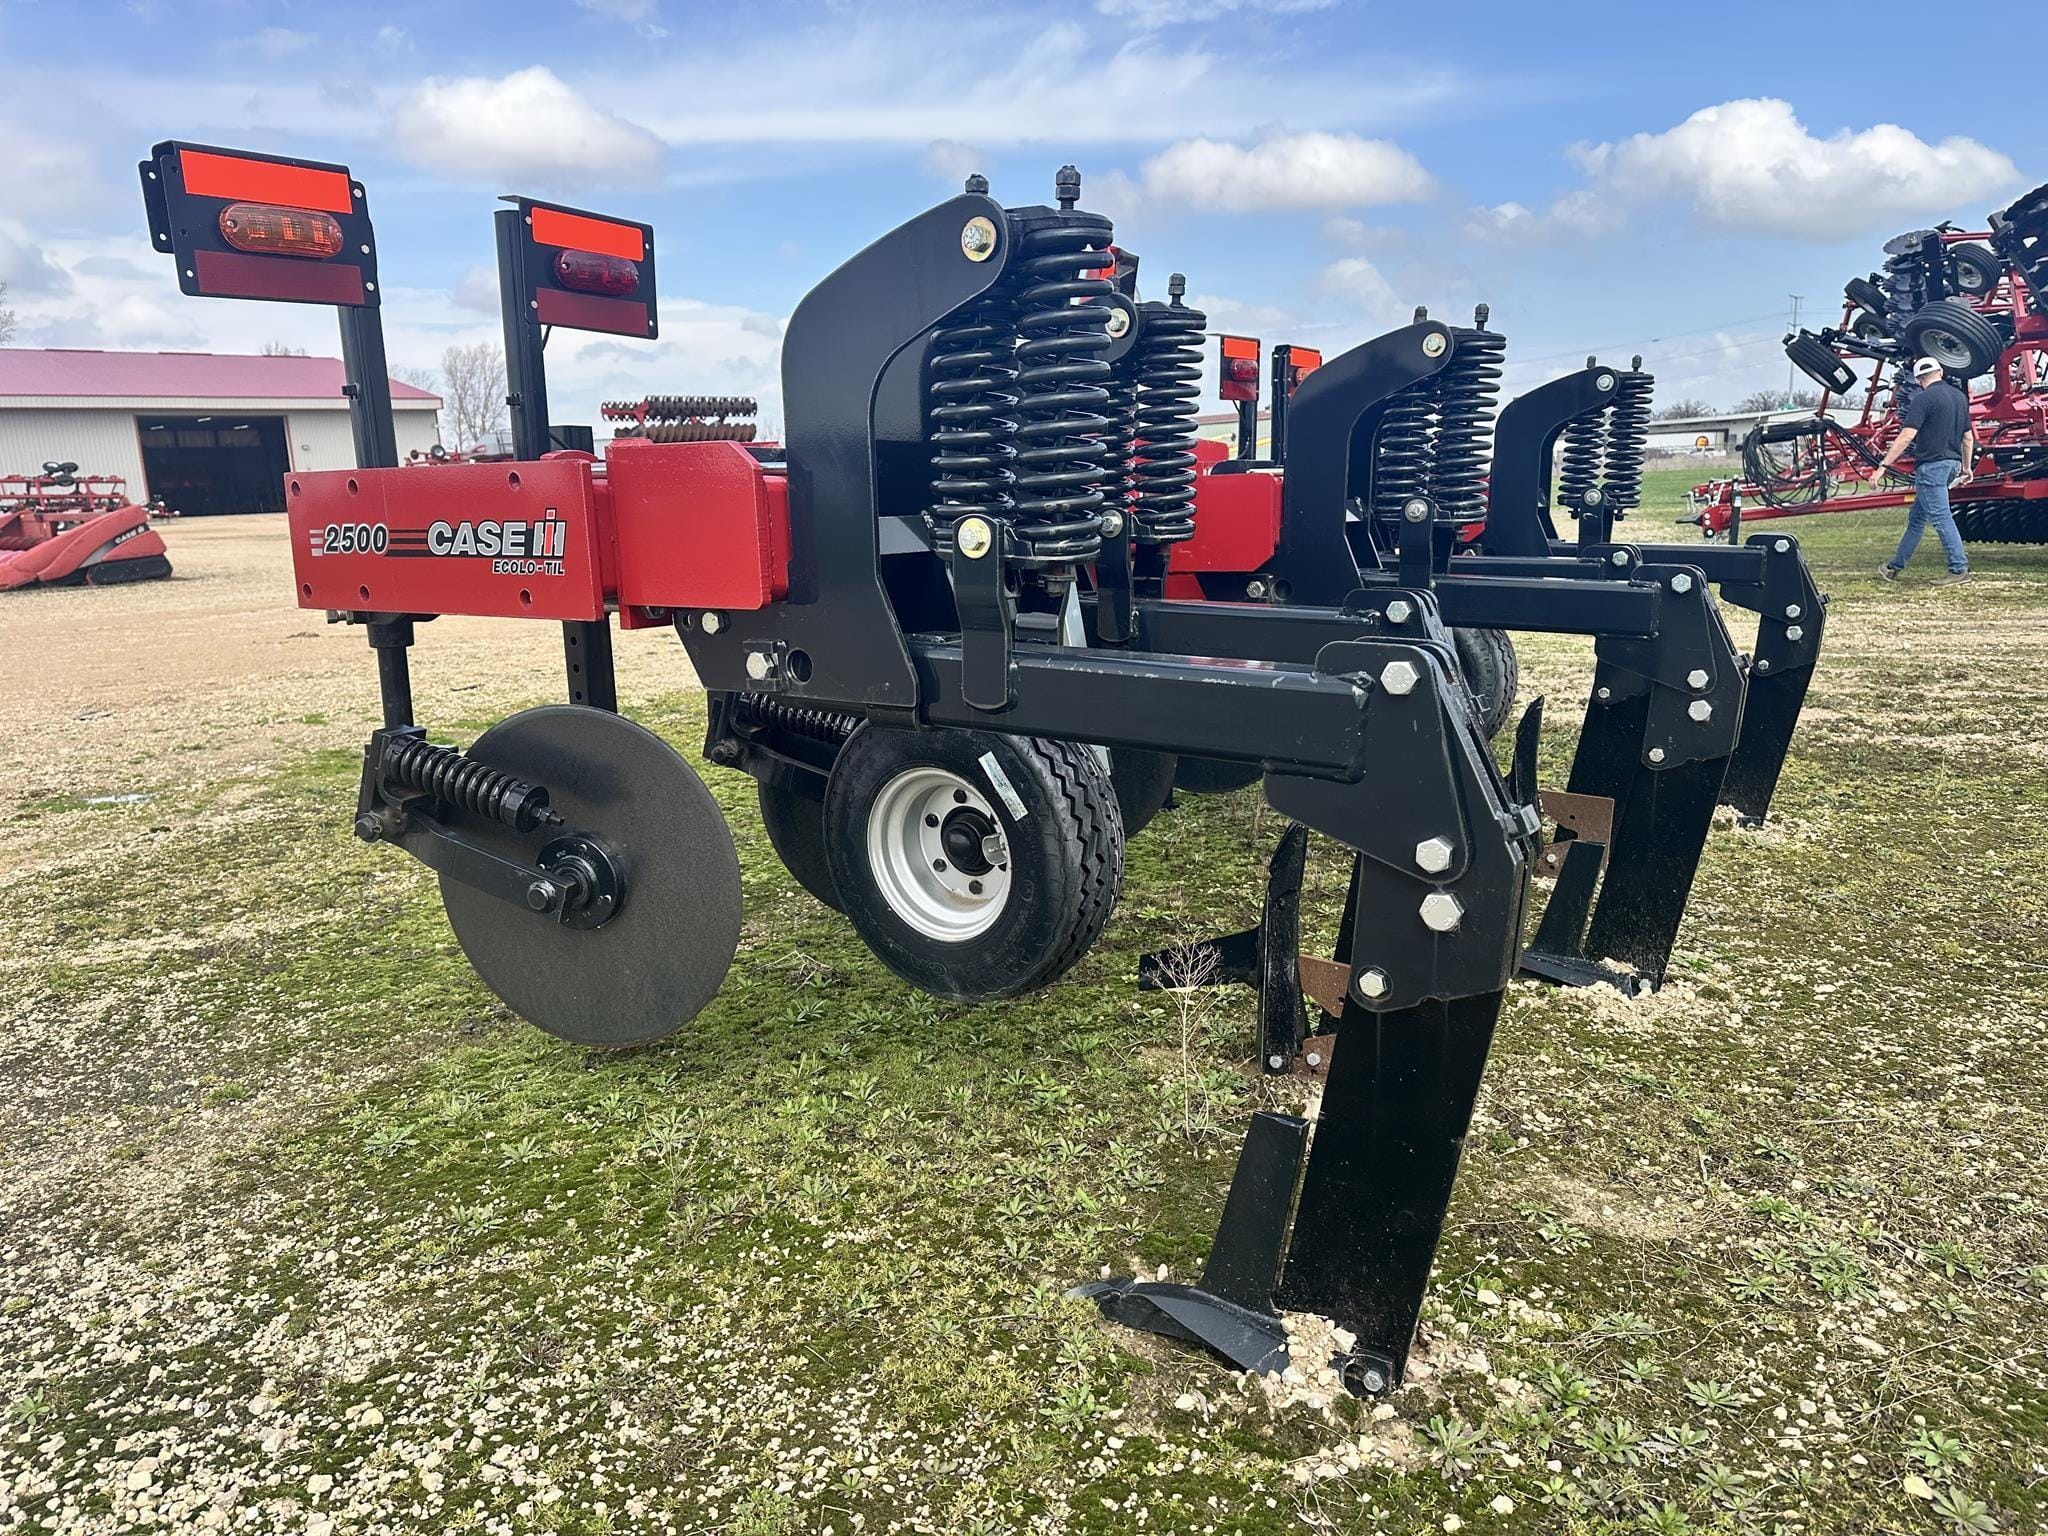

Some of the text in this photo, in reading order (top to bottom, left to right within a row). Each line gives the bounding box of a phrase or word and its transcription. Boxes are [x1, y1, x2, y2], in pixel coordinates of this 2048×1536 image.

[323, 523, 388, 555] 2500
[427, 520, 526, 556] CASE
[492, 560, 565, 575] ECOLO-TIL
